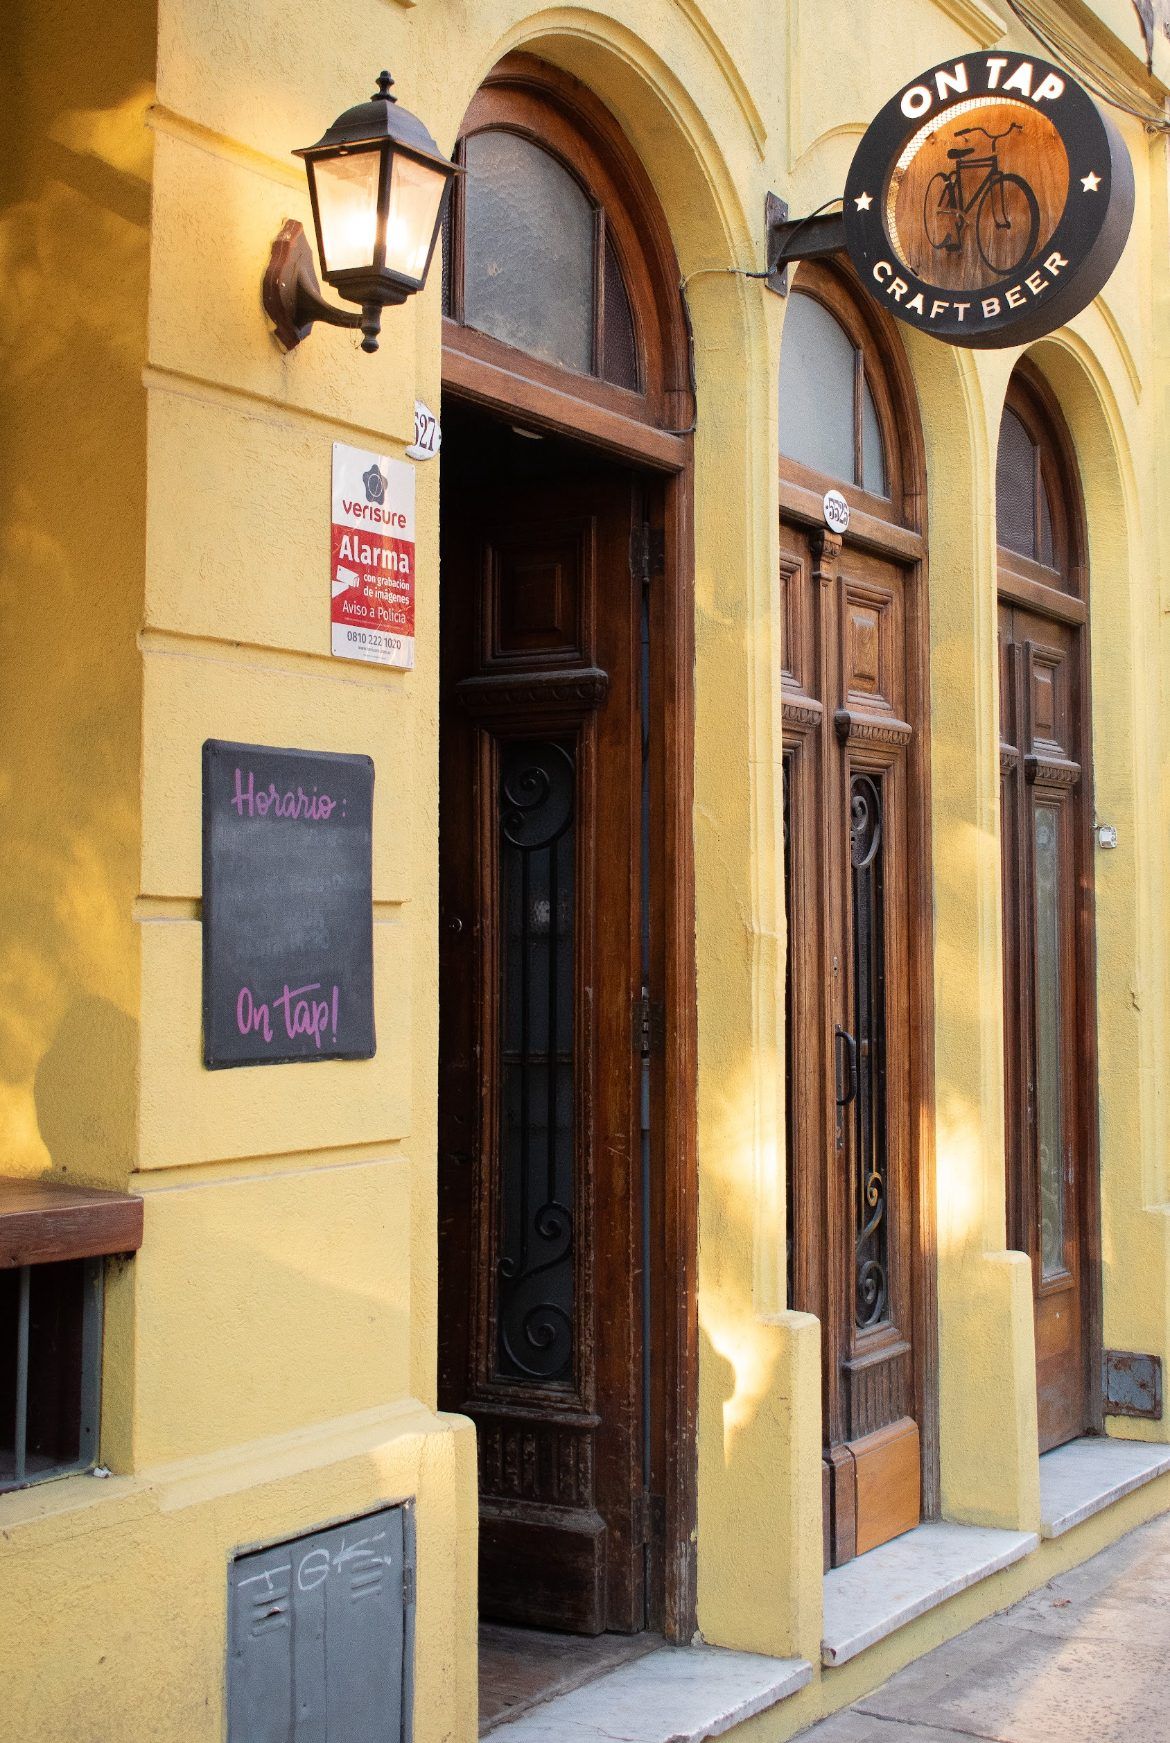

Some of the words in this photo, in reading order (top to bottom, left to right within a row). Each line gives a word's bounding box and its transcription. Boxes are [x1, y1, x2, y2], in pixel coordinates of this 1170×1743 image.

[900, 62, 969, 118] ON
[986, 58, 1066, 103] TAP
[872, 260, 971, 322] CRAFT
[981, 251, 1069, 319] BEER
[342, 499, 407, 529] verisure
[339, 534, 410, 574] Alarma
[363, 573, 376, 583] con
[377, 576, 410, 591] grabación
[363, 586, 374, 598] de
[375, 587, 410, 605] imágenes
[342, 600, 368, 617] Aviso
[369, 607, 375, 618] a
[347, 630, 367, 644] 0810
[368, 634, 383, 647] 222
[384, 637, 402, 650] 1020
[236, 987, 274, 1043] On
[272, 982, 339, 1049] tap!
